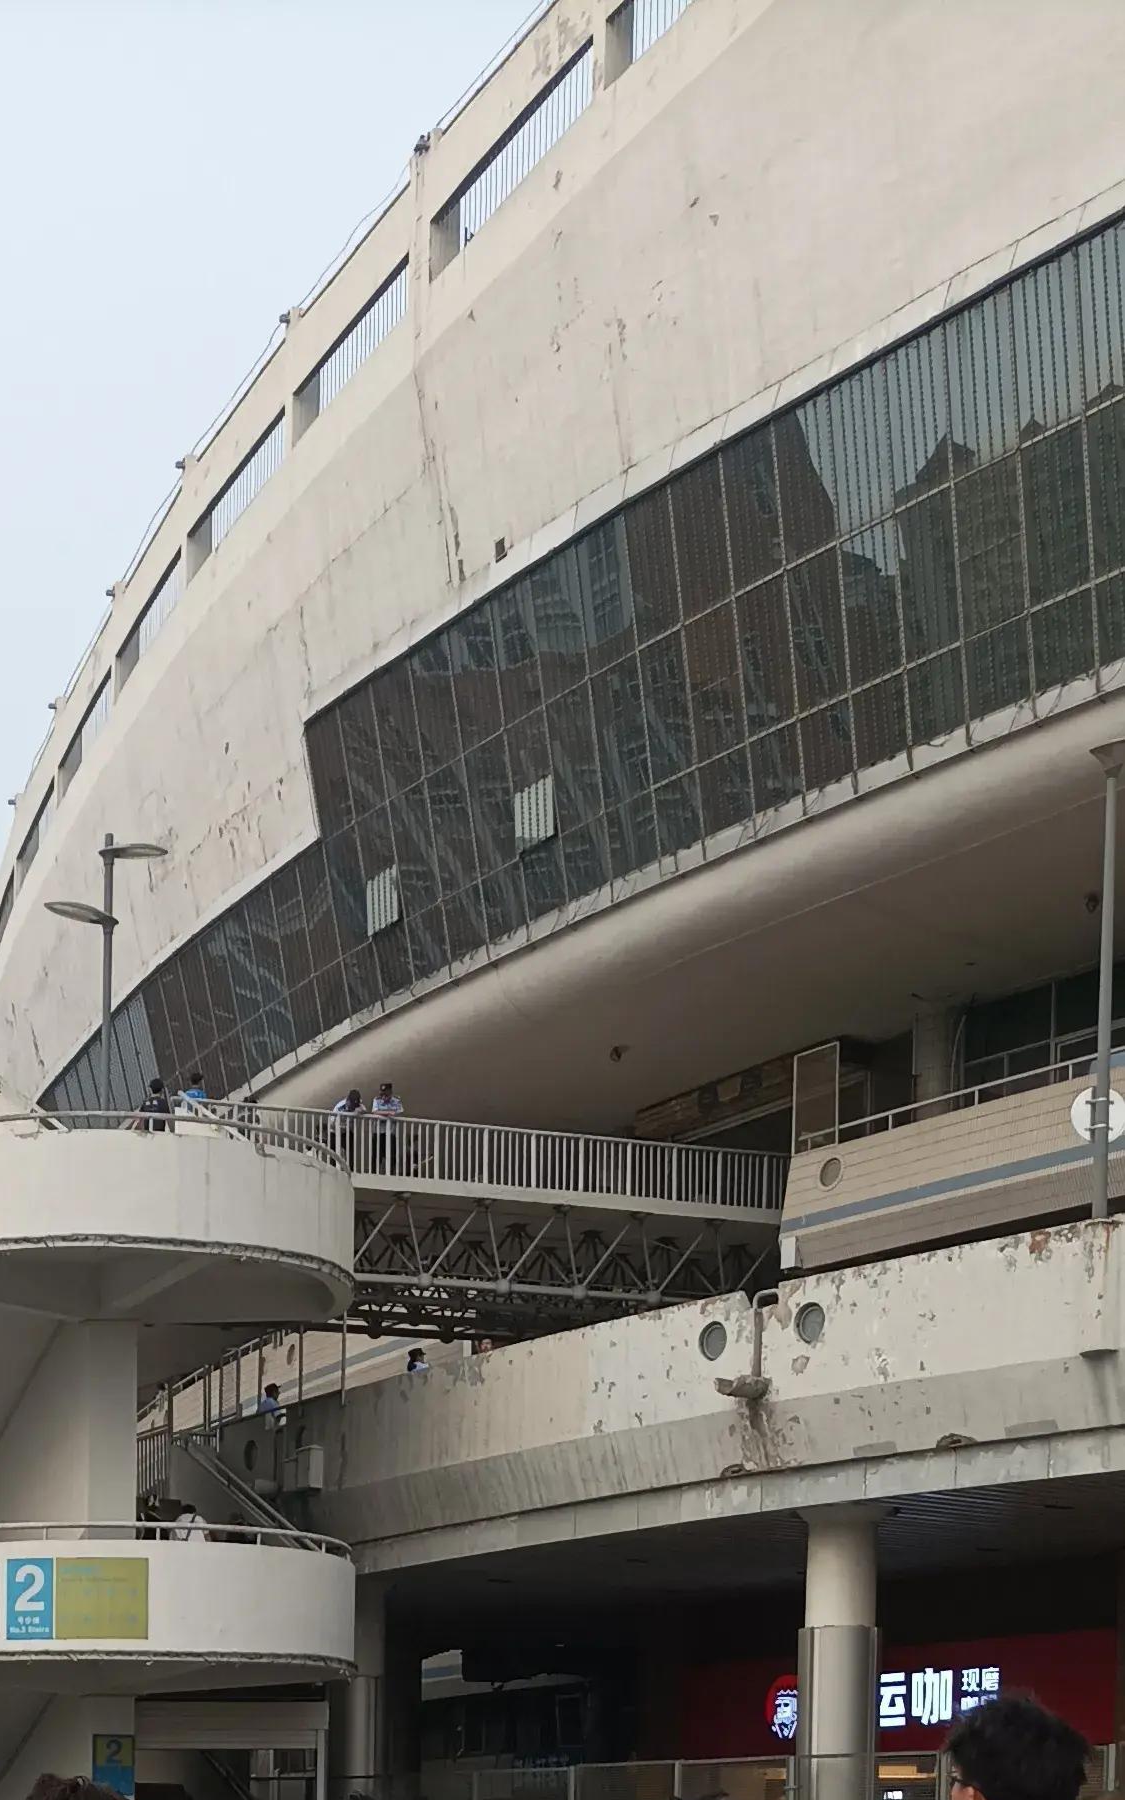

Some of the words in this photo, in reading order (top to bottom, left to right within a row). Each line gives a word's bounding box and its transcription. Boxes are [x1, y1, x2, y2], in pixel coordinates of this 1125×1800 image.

[14, 1564, 45, 1612] 2
[961, 1667, 1000, 1692] 现磨
[106, 1738, 124, 1764] 2
